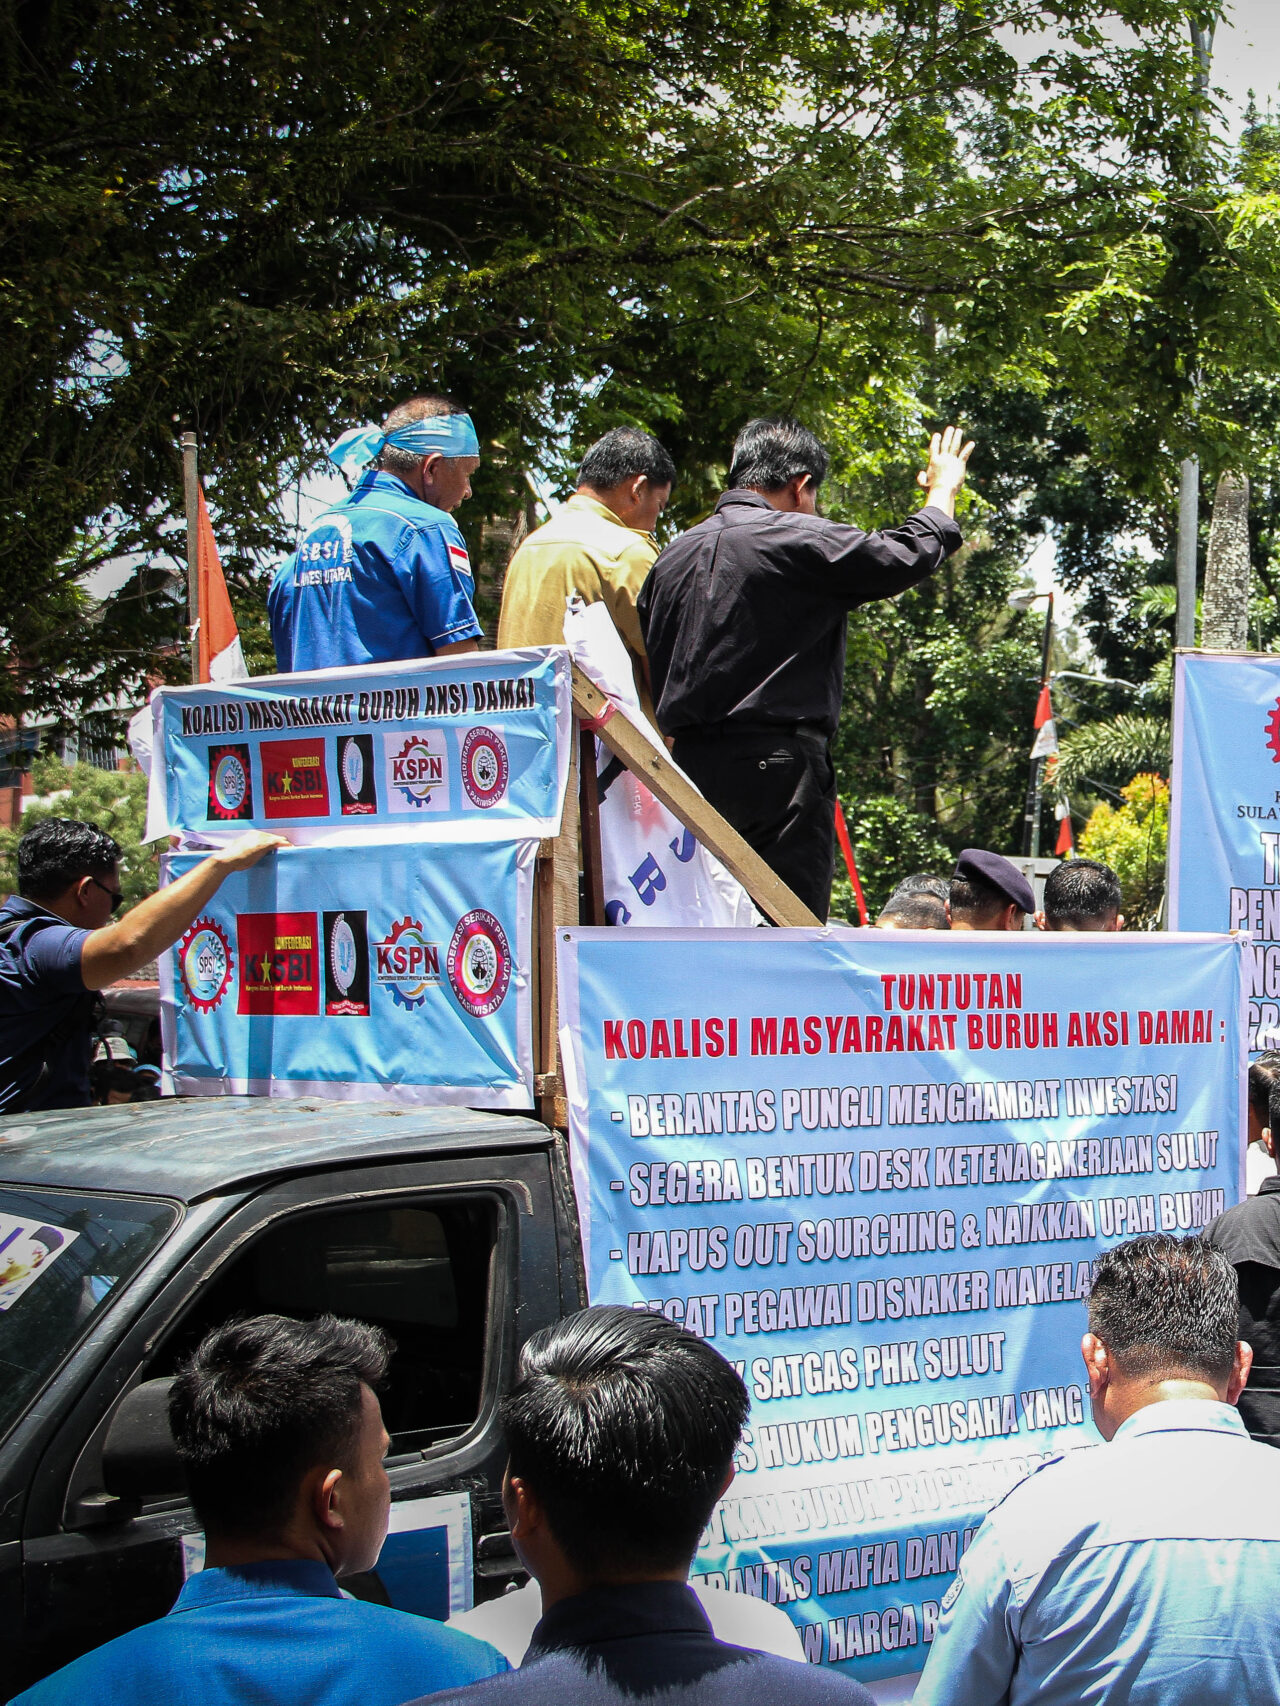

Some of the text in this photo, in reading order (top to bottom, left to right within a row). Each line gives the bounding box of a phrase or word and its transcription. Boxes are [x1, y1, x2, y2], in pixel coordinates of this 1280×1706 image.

[301, 540, 340, 562] SBSI
[324, 566, 352, 584] UTARA
[182, 677, 536, 736] KOALISI MASYARAKAT BURUH AKSI DAMAI
[393, 757, 443, 780] KSPN
[377, 946, 440, 974] KSPN
[448, 911, 511, 981] FEDERASI SERIKAT PEKERJA
[458, 993, 502, 1015] PARIWISATA
[881, 972, 1022, 1011] TUNTUTAN
[603, 1017, 738, 1061] KOALISI
[751, 1012, 957, 1056] MASYARAKAT
[967, 1009, 1059, 1051] BURUH
[1067, 1009, 1130, 1047] AKSI
[1138, 1009, 1214, 1045] DAMAI
[629, 1089, 776, 1138] BERANTAS
[782, 1084, 882, 1131] PUNGLI
[889, 1078, 1061, 1126] MENGHAMBAT
[1065, 1075, 1178, 1117] INVESTASI
[629, 1158, 742, 1207] SEGERA
[747, 1153, 854, 1200] BENTUK
[859, 1147, 929, 1193] DESK
[934, 1135, 1153, 1188] KETENAGAKERJAAN
[1157, 1131, 1219, 1171] SULUT
[628, 1228, 727, 1276] HAPUS
[734, 1222, 792, 1268] OUT
[797, 1210, 955, 1263] SOURCHING
[961, 1210, 981, 1249] &
[984, 1200, 1097, 1247] NAIKKAN
[1098, 1195, 1157, 1238] UPAH
[1161, 1188, 1225, 1232] BURUH
[726, 1283, 852, 1337] PEGAWAI
[857, 1270, 988, 1324] DISNAKER
[994, 1259, 1095, 1308] MAKELA
[752, 1346, 859, 1401] SATGAS
[864, 1339, 920, 1388] PHK
[924, 1331, 1007, 1379] SULUT
[758, 1414, 862, 1468] HUKUM
[865, 1395, 1019, 1454] PENGUSAHA
[1021, 1383, 1084, 1431] YANG
[817, 1540, 900, 1597] MAFIA
[905, 1530, 958, 1580] DAN
[828, 1604, 917, 1663] HARGA
